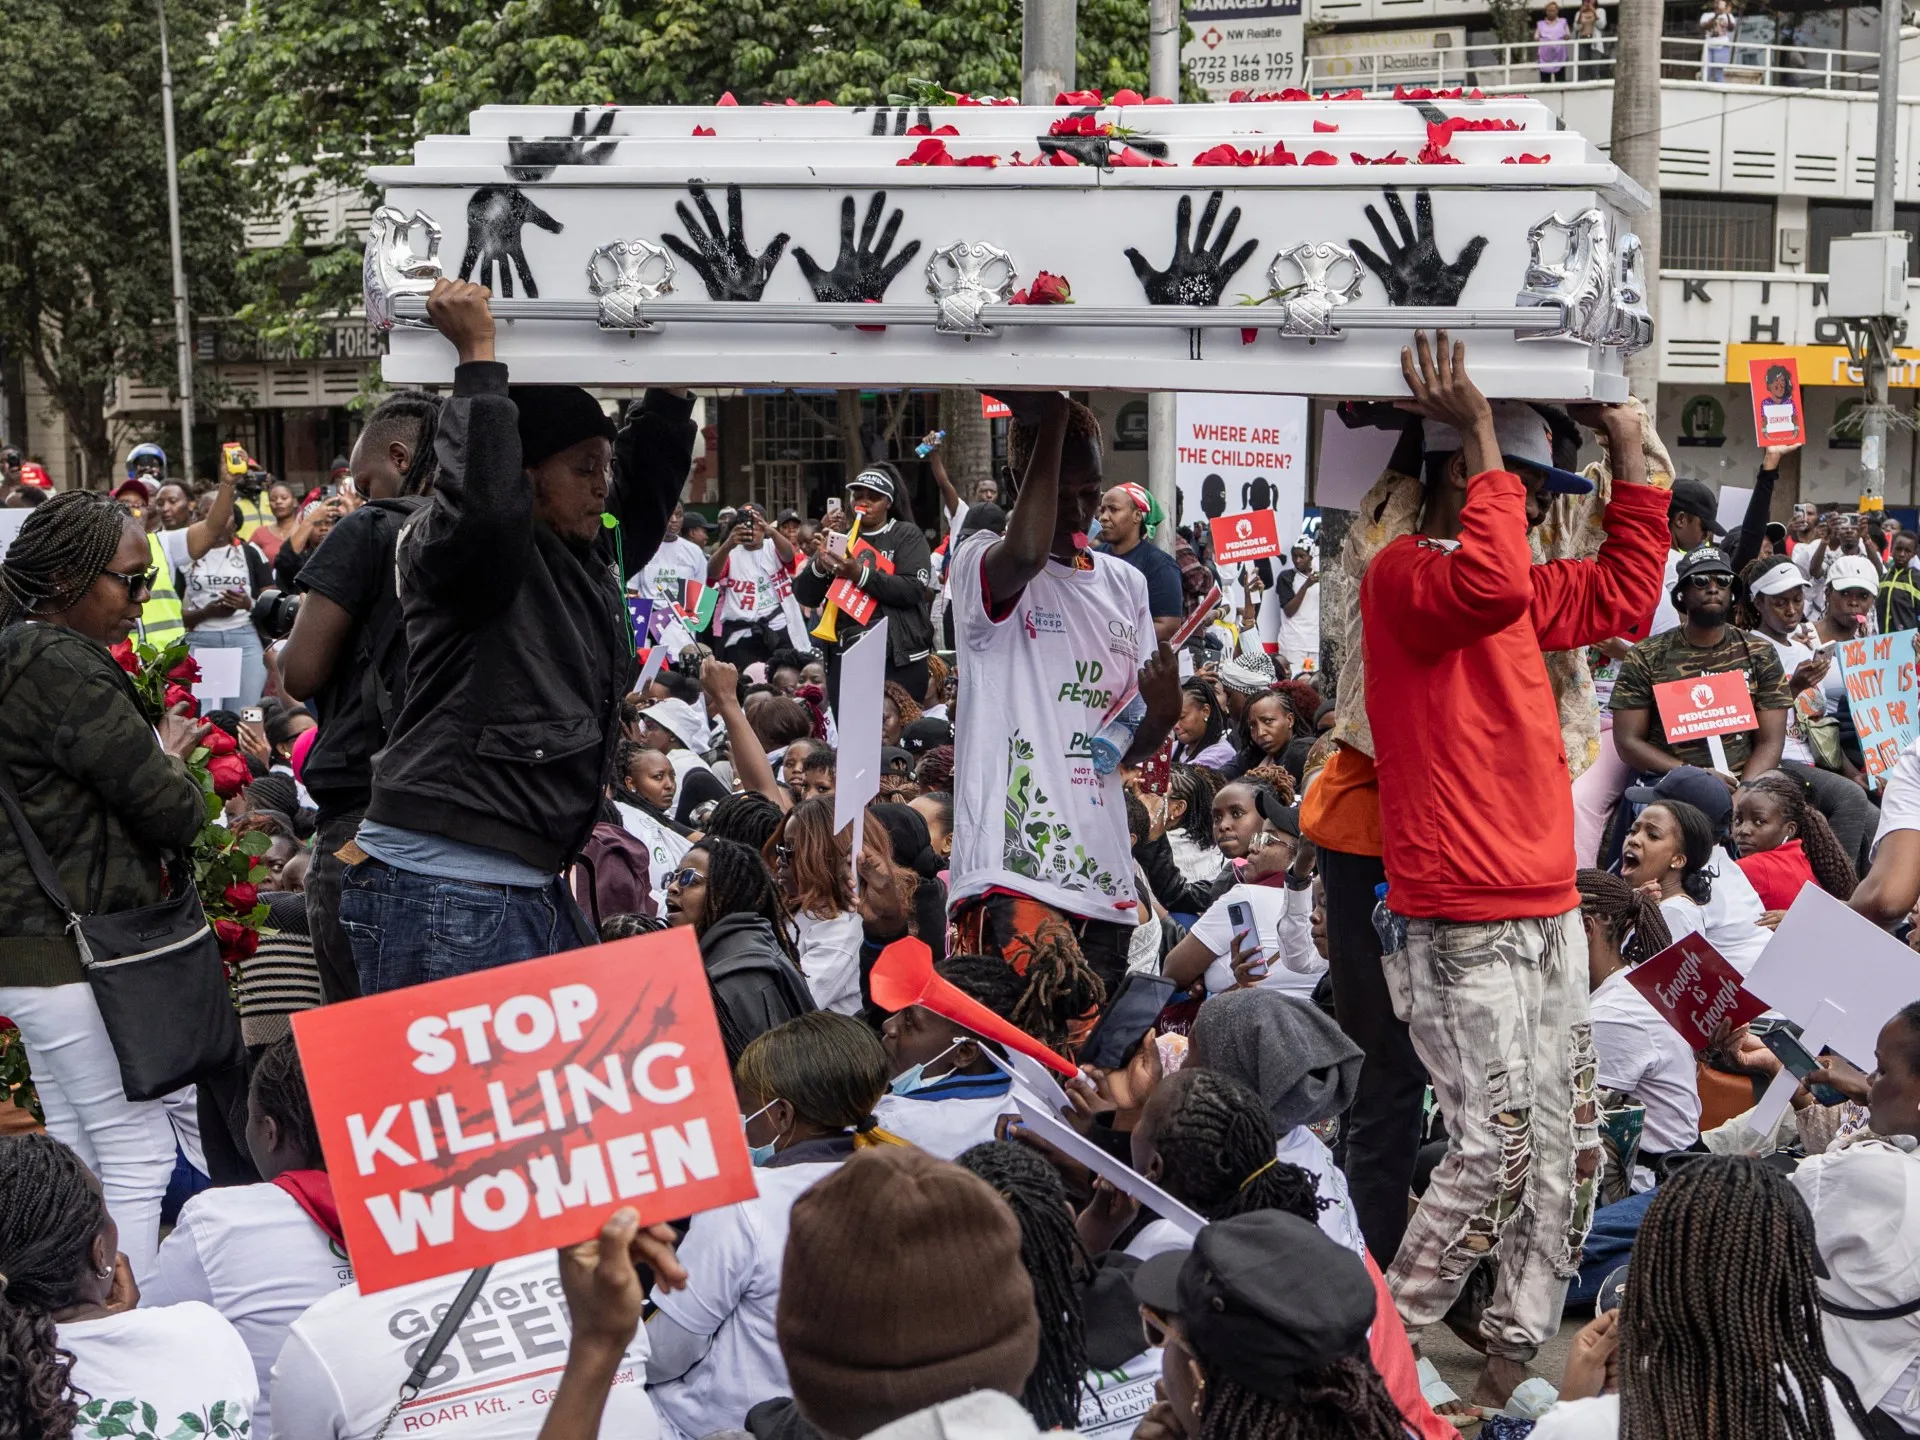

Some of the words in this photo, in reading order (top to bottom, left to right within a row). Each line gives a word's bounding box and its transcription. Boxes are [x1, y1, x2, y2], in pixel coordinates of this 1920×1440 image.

[1227, 30, 1244, 40] NW
[1247, 28, 1282, 38] Realite
[1188, 56, 1226, 69] 0722
[1233, 54, 1261, 67] 144
[1267, 52, 1293, 65] 105
[1384, 54, 1429, 69] Realite
[1189, 71, 1225, 84] 0795
[1231, 69, 1259, 82] 888
[1265, 67, 1292, 80] 777
[1193, 424, 1247, 443] WHERE
[1251, 428, 1280, 445] ARE
[1178, 448, 1207, 464] THE
[1211, 450, 1292, 470] CHILDREN?
[1220, 552, 1232, 561] AN
[1231, 544, 1277, 558] EMERGENCY
[1225, 538, 1259, 551] PEDICIDE
[1259, 536, 1268, 545] IS
[1874, 636, 1894, 660] MY
[1898, 662, 1914, 692] IS
[1670, 725, 1688, 737] AN
[1688, 714, 1751, 732] EMERGENCY
[1678, 707, 1726, 723] PEDICIDE
[1726, 705, 1737, 715] IS
[1886, 700, 1910, 728] FOR
[1655, 948, 1702, 1009] Enough
[1687, 985, 1707, 1004] is
[1690, 975, 1740, 1037] Enough
[406, 983, 598, 1075] STOP
[345, 1042, 696, 1177] KILLING
[364, 1118, 720, 1256] WOMEN
[388, 1277, 563, 1340] Genera
[403, 1404, 469, 1432] ROAR
[475, 1397, 511, 1418] Kft.
